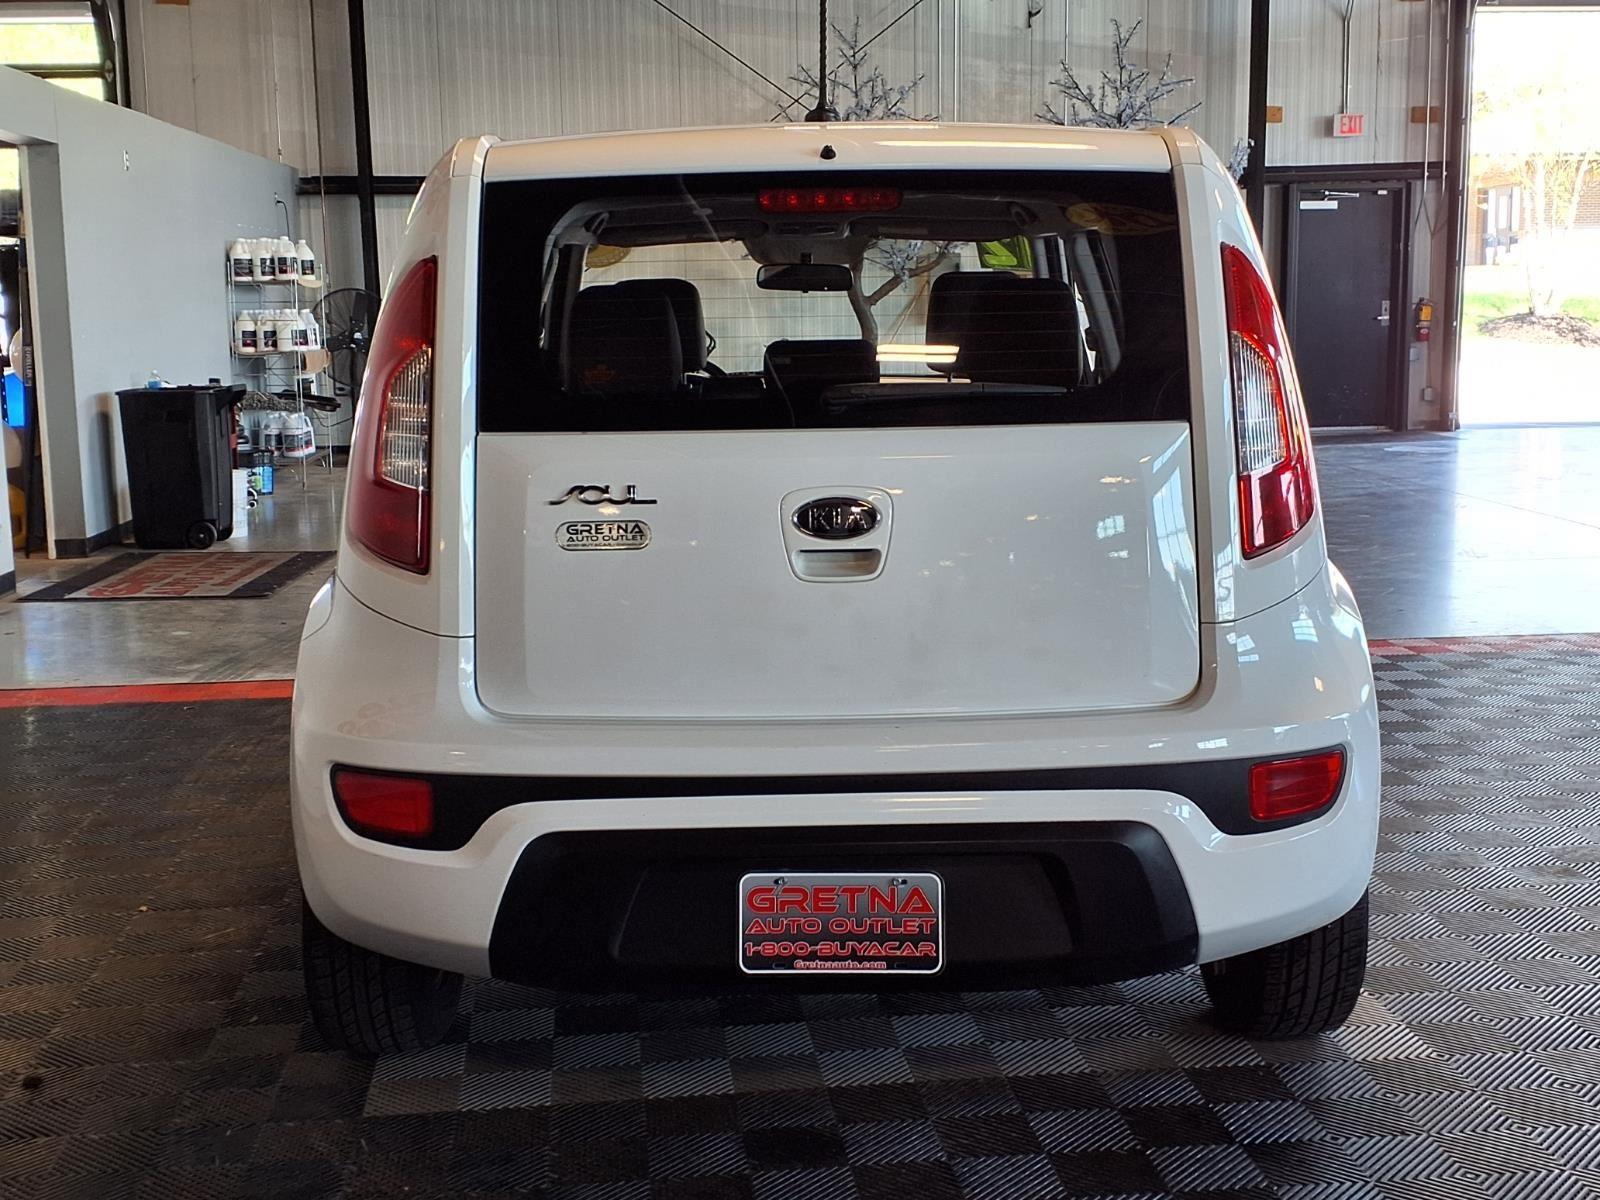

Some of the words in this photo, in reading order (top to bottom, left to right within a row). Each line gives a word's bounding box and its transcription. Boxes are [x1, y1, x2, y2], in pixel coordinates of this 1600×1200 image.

[1340, 114, 1364, 134] EXIT
[547, 485, 658, 505] SOUL
[808, 507, 867, 530] KIA
[566, 523, 644, 536] GRETNA
[566, 535, 599, 543] AUTO
[602, 534, 645, 542] OUTLET
[745, 885, 936, 914] GRETNA
[744, 917, 822, 935] AUTO
[828, 917, 937, 934] OUTLET
[744, 941, 937, 957] 1-800-BUYACAR
[793, 959, 887, 970] Gretnaauto.com
